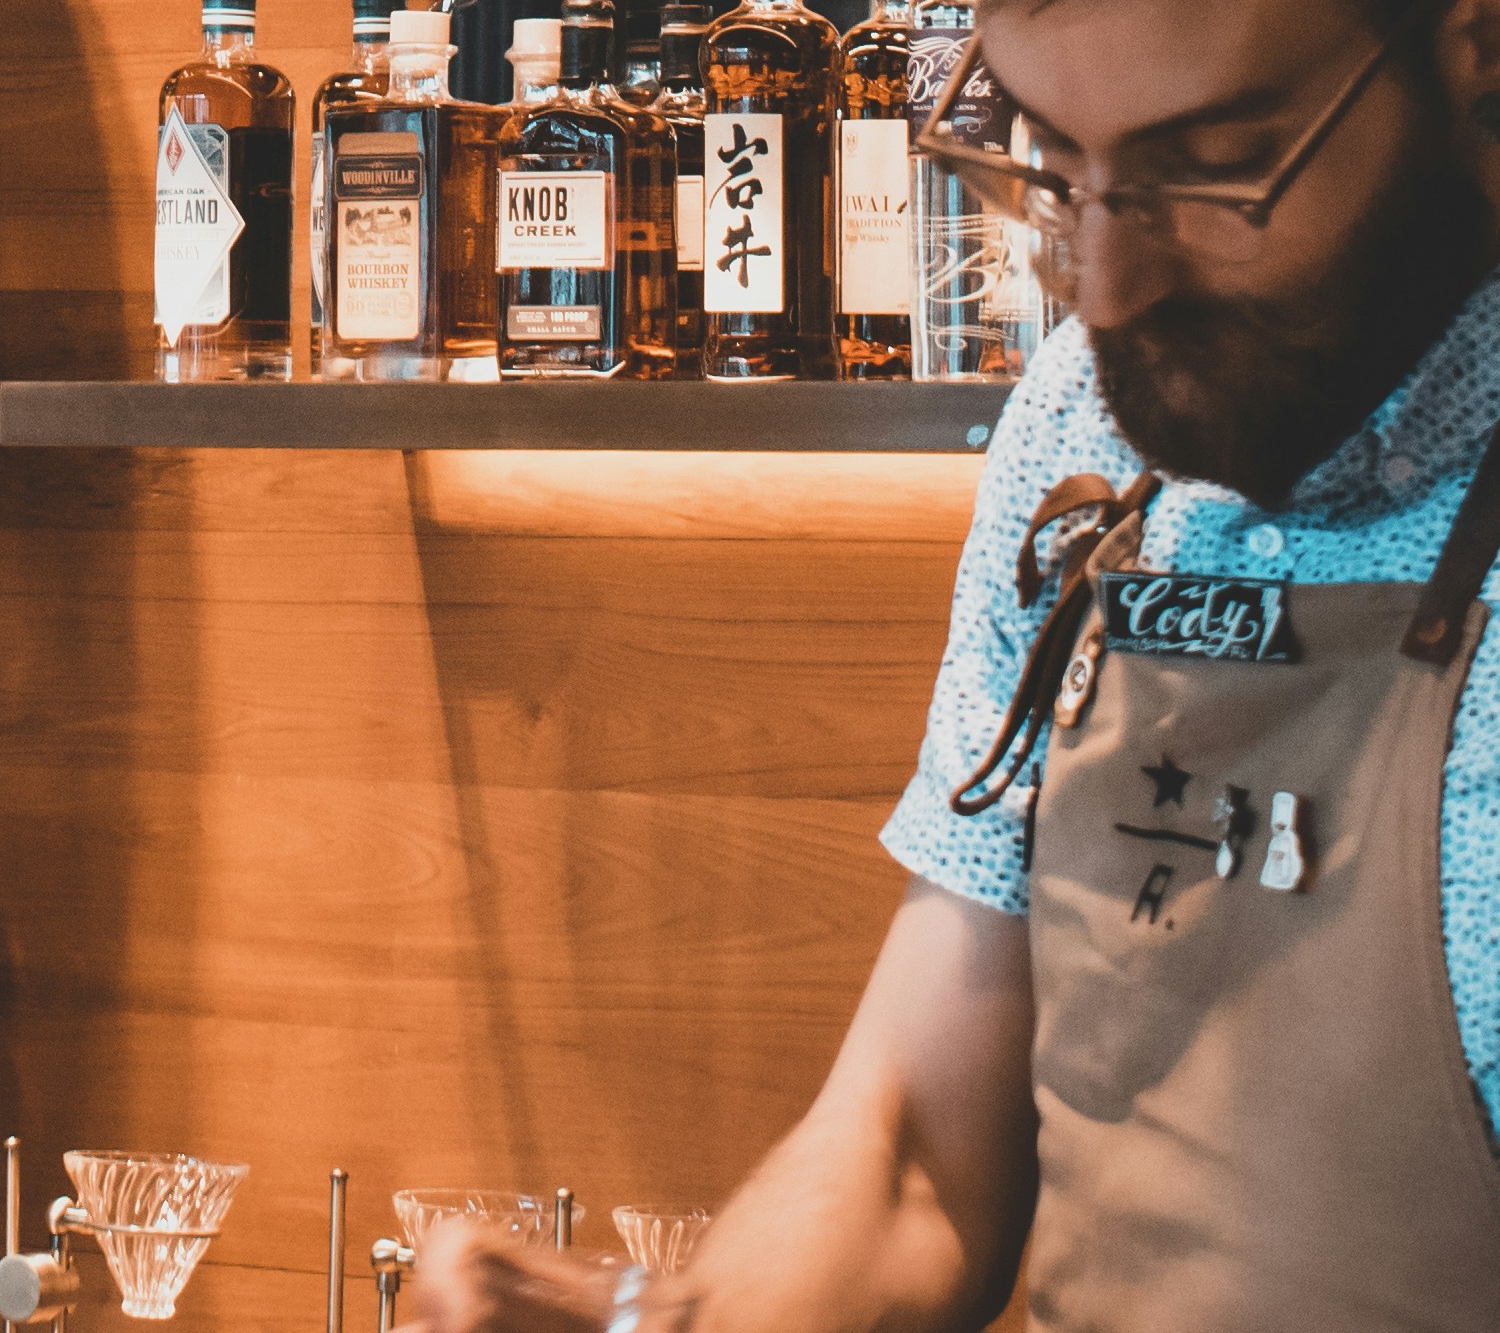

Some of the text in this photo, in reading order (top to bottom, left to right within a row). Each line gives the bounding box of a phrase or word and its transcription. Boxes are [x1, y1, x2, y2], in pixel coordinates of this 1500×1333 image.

[342, 170, 415, 186] WOODINVILLE
[508, 185, 568, 223] KNOB
[709, 122, 772, 289] 岩井
[514, 225, 577, 237] CREEK
[347, 263, 409, 275] BOURBON
[347, 277, 409, 289] WHISKEY
